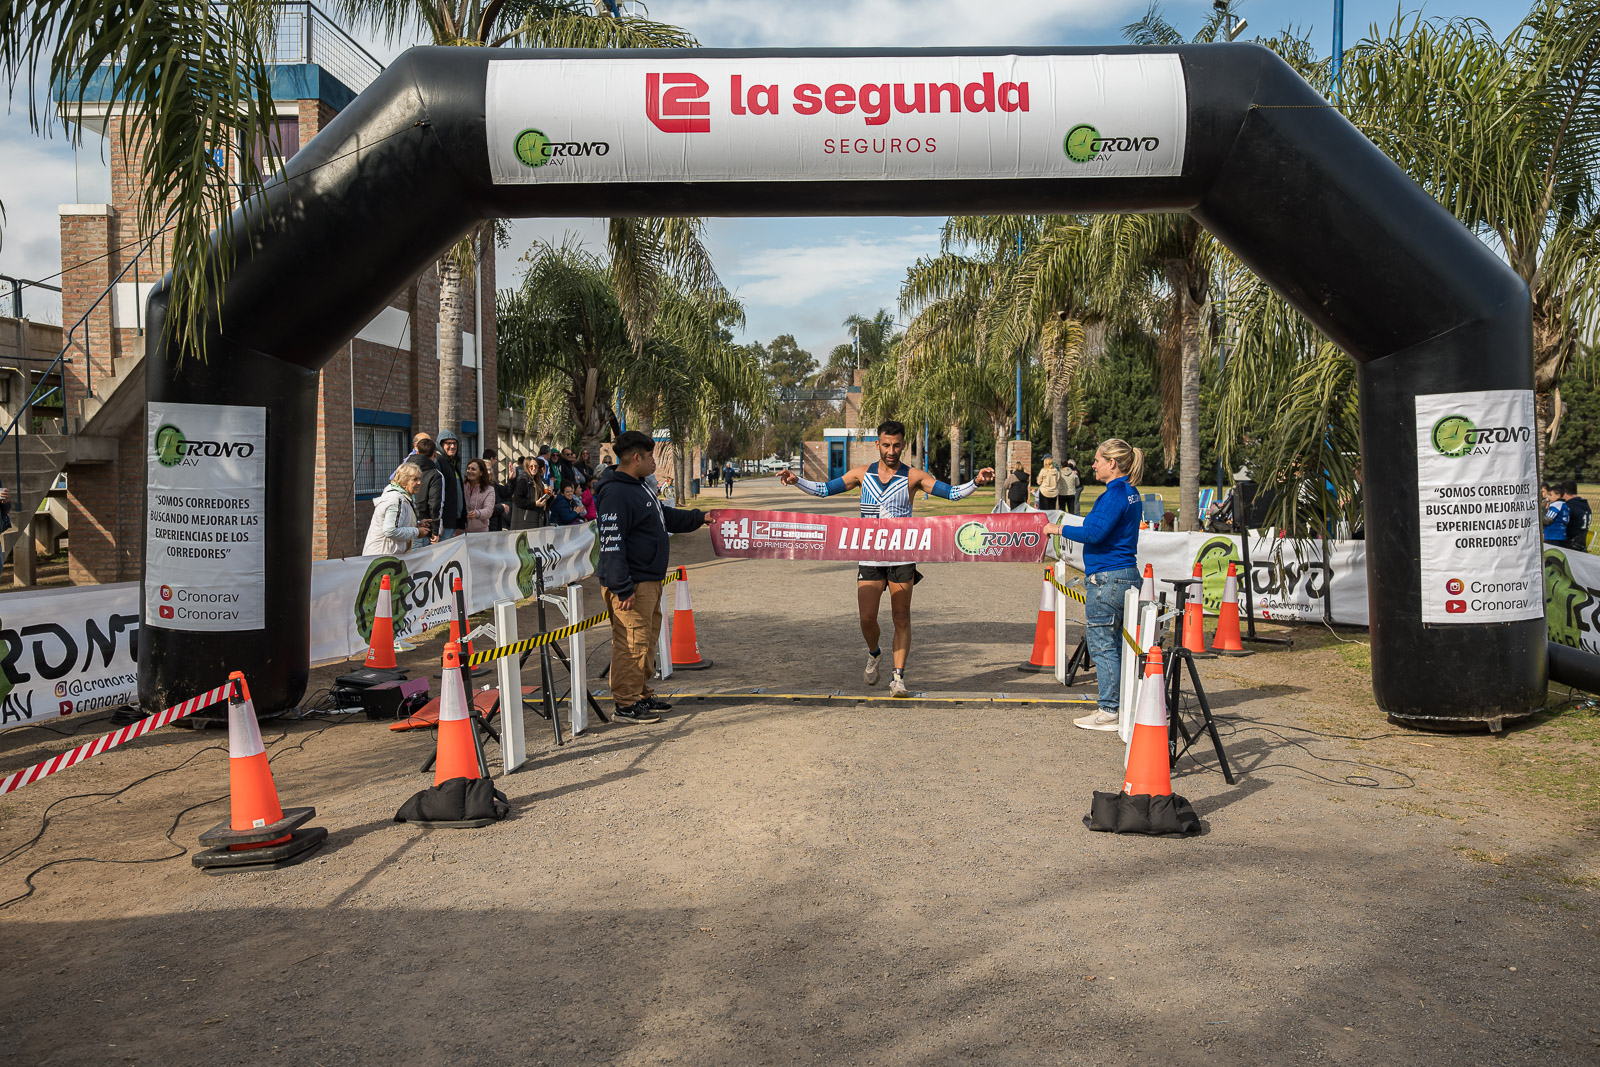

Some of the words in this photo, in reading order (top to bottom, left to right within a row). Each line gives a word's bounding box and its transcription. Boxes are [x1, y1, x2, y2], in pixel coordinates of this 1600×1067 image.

[730, 74, 779, 115] la
[792, 72, 1030, 126] segunda
[823, 137, 937, 154] SEGUROS
[540, 158, 564, 166] RAV
[1463, 446, 1491, 456] RAV
[174, 457, 200, 467] RAV
[1478, 483, 1530, 497] CORREDORES
[185, 497, 250, 509] CORREDORES
[1426, 503, 1482, 516] BUSCANDO
[1484, 501, 1524, 514] MEJORAR
[1525, 499, 1536, 511] LAS
[150, 510, 189, 524] BUSCANDO
[191, 514, 238, 526] MEJORAR
[240, 515, 258, 526] LAS
[1436, 519, 1506, 532] EXPERIENCIAS
[1508, 519, 1519, 530] DE
[1520, 517, 1531, 529] LOS
[720, 517, 750, 538] #1
[155, 528, 213, 542] EXPERIENCIAS
[215, 532, 229, 542] DE
[231, 532, 249, 542] LOS
[771, 529, 782, 538] La
[782, 530, 824, 540] segunda
[838, 527, 932, 550] LLEGADA
[723, 538, 750, 550] VOS
[764, 541, 794, 549] PRIMERO
[794, 542, 809, 550] SOS
[978, 547, 1003, 556] RAV
[1470, 581, 1529, 594] Cronorav
[177, 590, 240, 603] Cronorav
[1470, 599, 1529, 612] Cronorav
[177, 607, 239, 620] Cronorav
[2, 689, 34, 725] AV
[76, 691, 132, 714] cronorav
